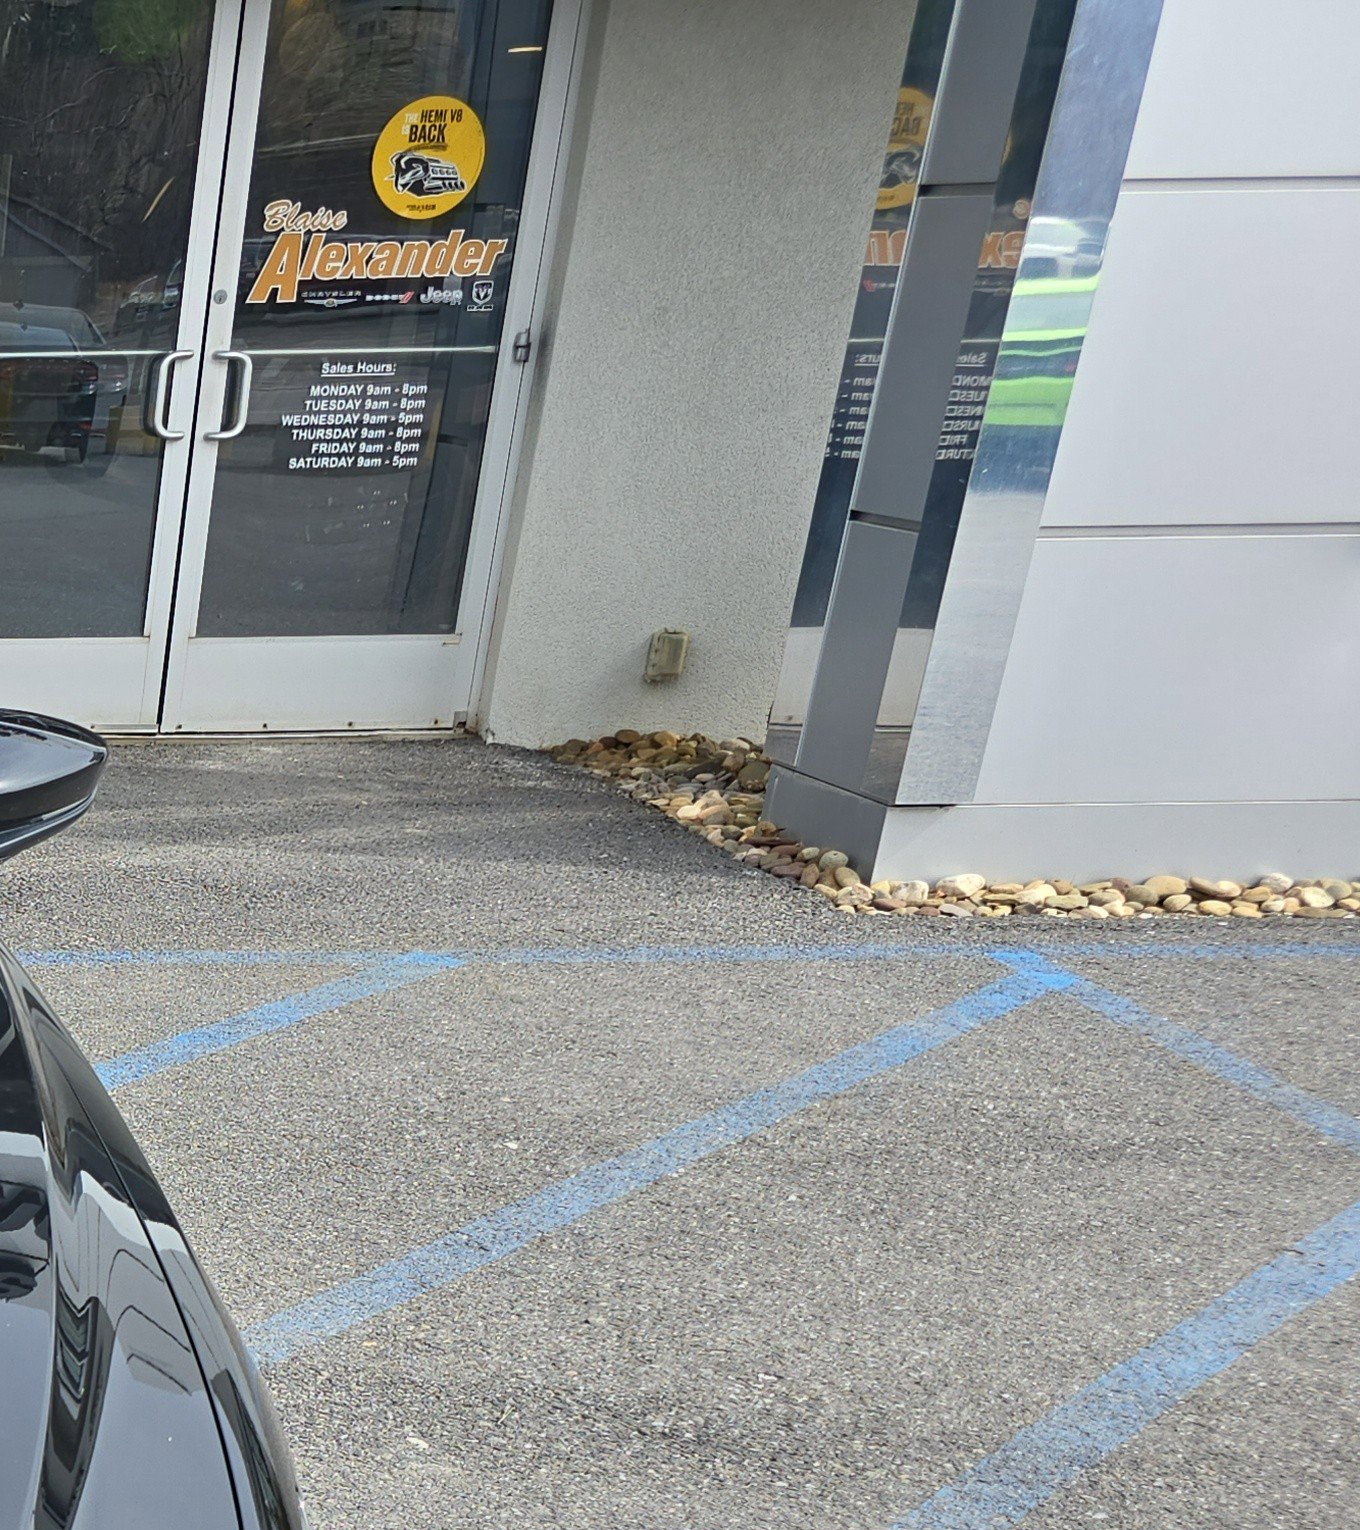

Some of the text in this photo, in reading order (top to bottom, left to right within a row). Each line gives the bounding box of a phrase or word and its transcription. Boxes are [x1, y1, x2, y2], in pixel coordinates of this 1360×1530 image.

[420, 109, 449, 124] HEMI
[450, 109, 463, 123] V8
[408, 124, 448, 143] BACK
[263, 199, 348, 233] Blaise
[245, 229, 508, 304] Alexander
[419, 286, 463, 305] Jeep
[321, 361, 397, 374] Sales Hours:
[310, 385, 363, 397] MONDAY
[366, 385, 391, 396] 9am
[402, 384, 428, 395] 8pm
[304, 399, 361, 411] TUESDAY
[364, 400, 389, 410] 9am
[400, 398, 426, 410] 8pm
[281, 414, 360, 426] WEDNESDAY
[362, 414, 387, 424] 9am
[398, 413, 424, 424] 5pm
[291, 428, 358, 441] THURSDAY
[360, 428, 385, 439] 9am
[396, 427, 422, 439] 8pm
[311, 443, 356, 455] FRIDAY
[359, 443, 384, 454] 9am
[394, 442, 419, 454] 8pm
[288, 457, 355, 469] SATURDAY
[357, 457, 382, 468] 9am
[392, 456, 418, 468] 5pm
